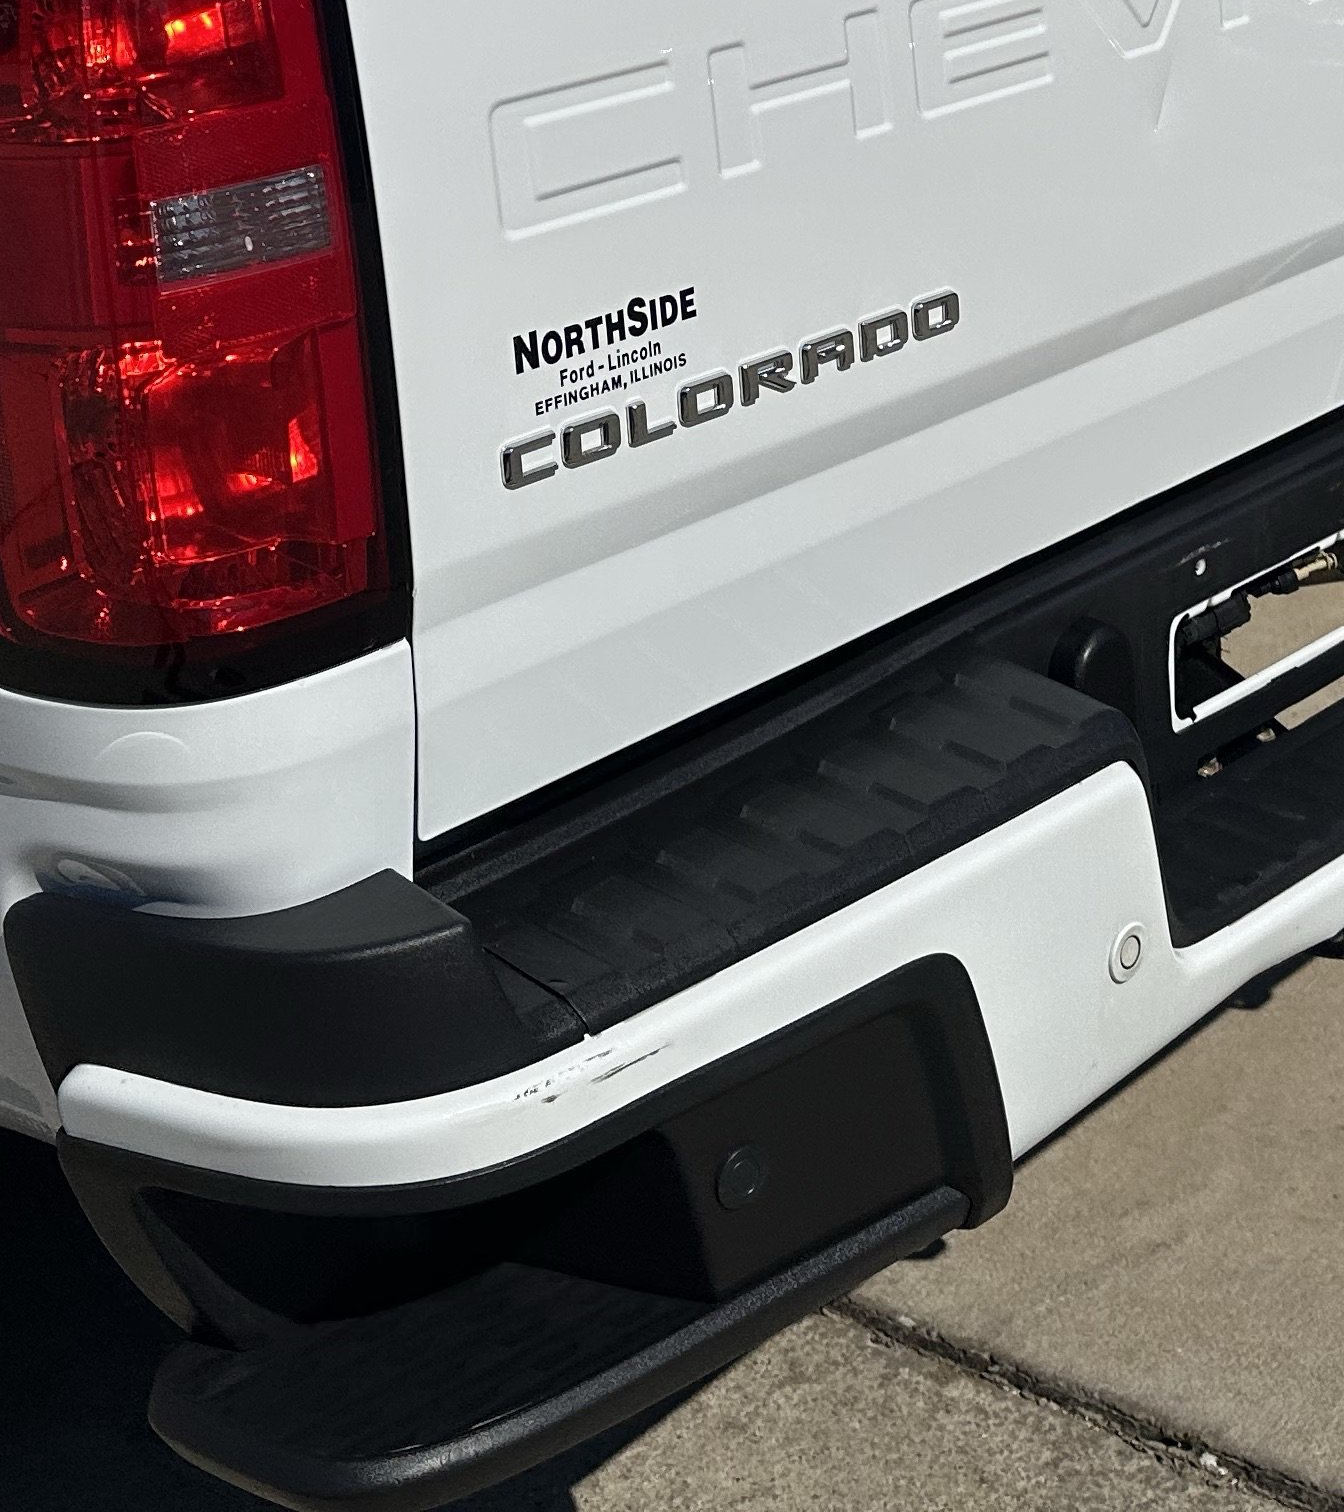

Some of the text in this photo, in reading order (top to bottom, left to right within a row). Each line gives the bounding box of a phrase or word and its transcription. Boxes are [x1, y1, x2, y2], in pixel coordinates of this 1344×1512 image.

[500, 288, 960, 490] COLORADO
[534, 352, 687, 416] EFFINGHAM, ILLINOIS
[559, 360, 595, 387] Ford
[607, 341, 662, 371] Lincoln
